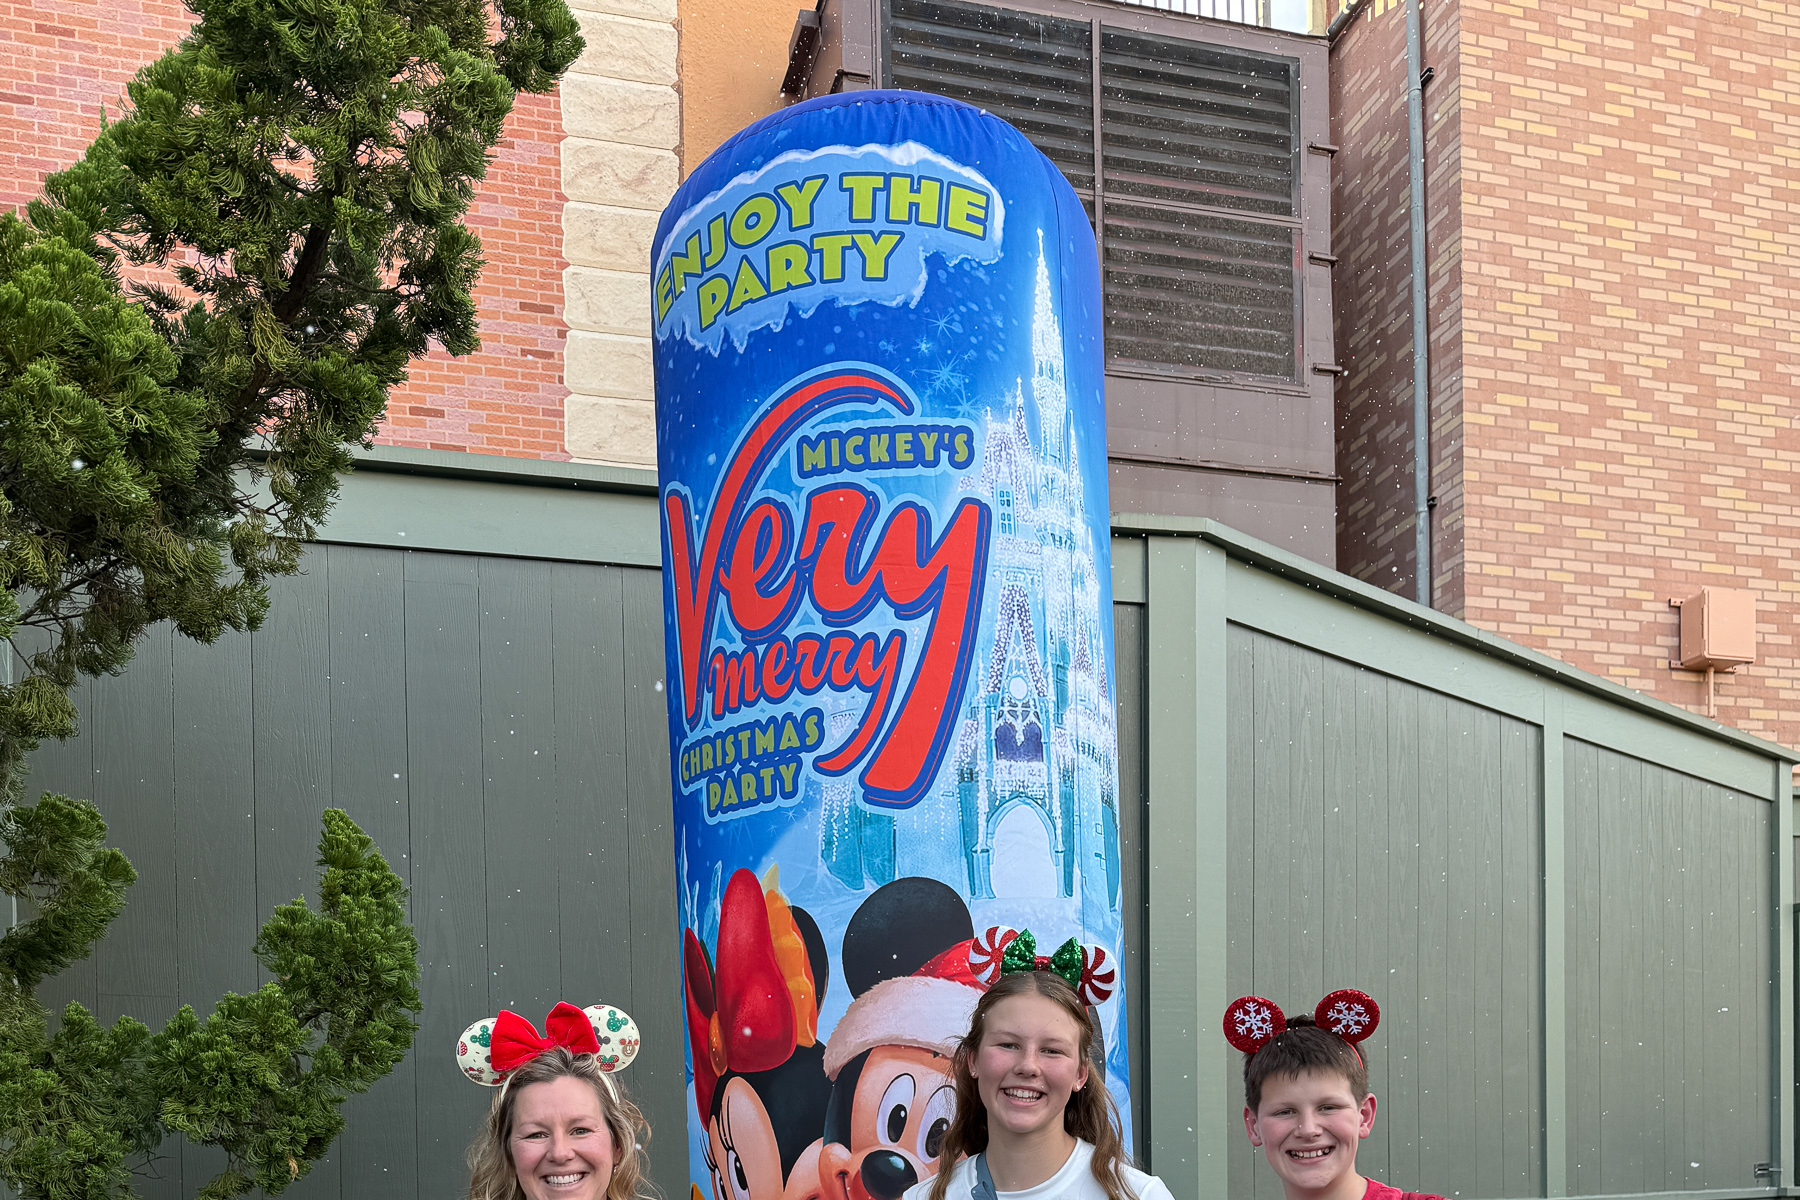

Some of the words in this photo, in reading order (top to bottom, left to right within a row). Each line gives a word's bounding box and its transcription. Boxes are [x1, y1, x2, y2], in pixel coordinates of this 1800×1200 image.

[656, 174, 826, 322] ENJOY
[839, 173, 990, 239] THE
[699, 231, 903, 330] PARTY
[800, 429, 971, 473] MICKEY'S
[667, 374, 984, 796] Very
[680, 714, 821, 780] CHRISTMAS
[709, 635, 902, 771] merry
[709, 762, 801, 811] PARTY
